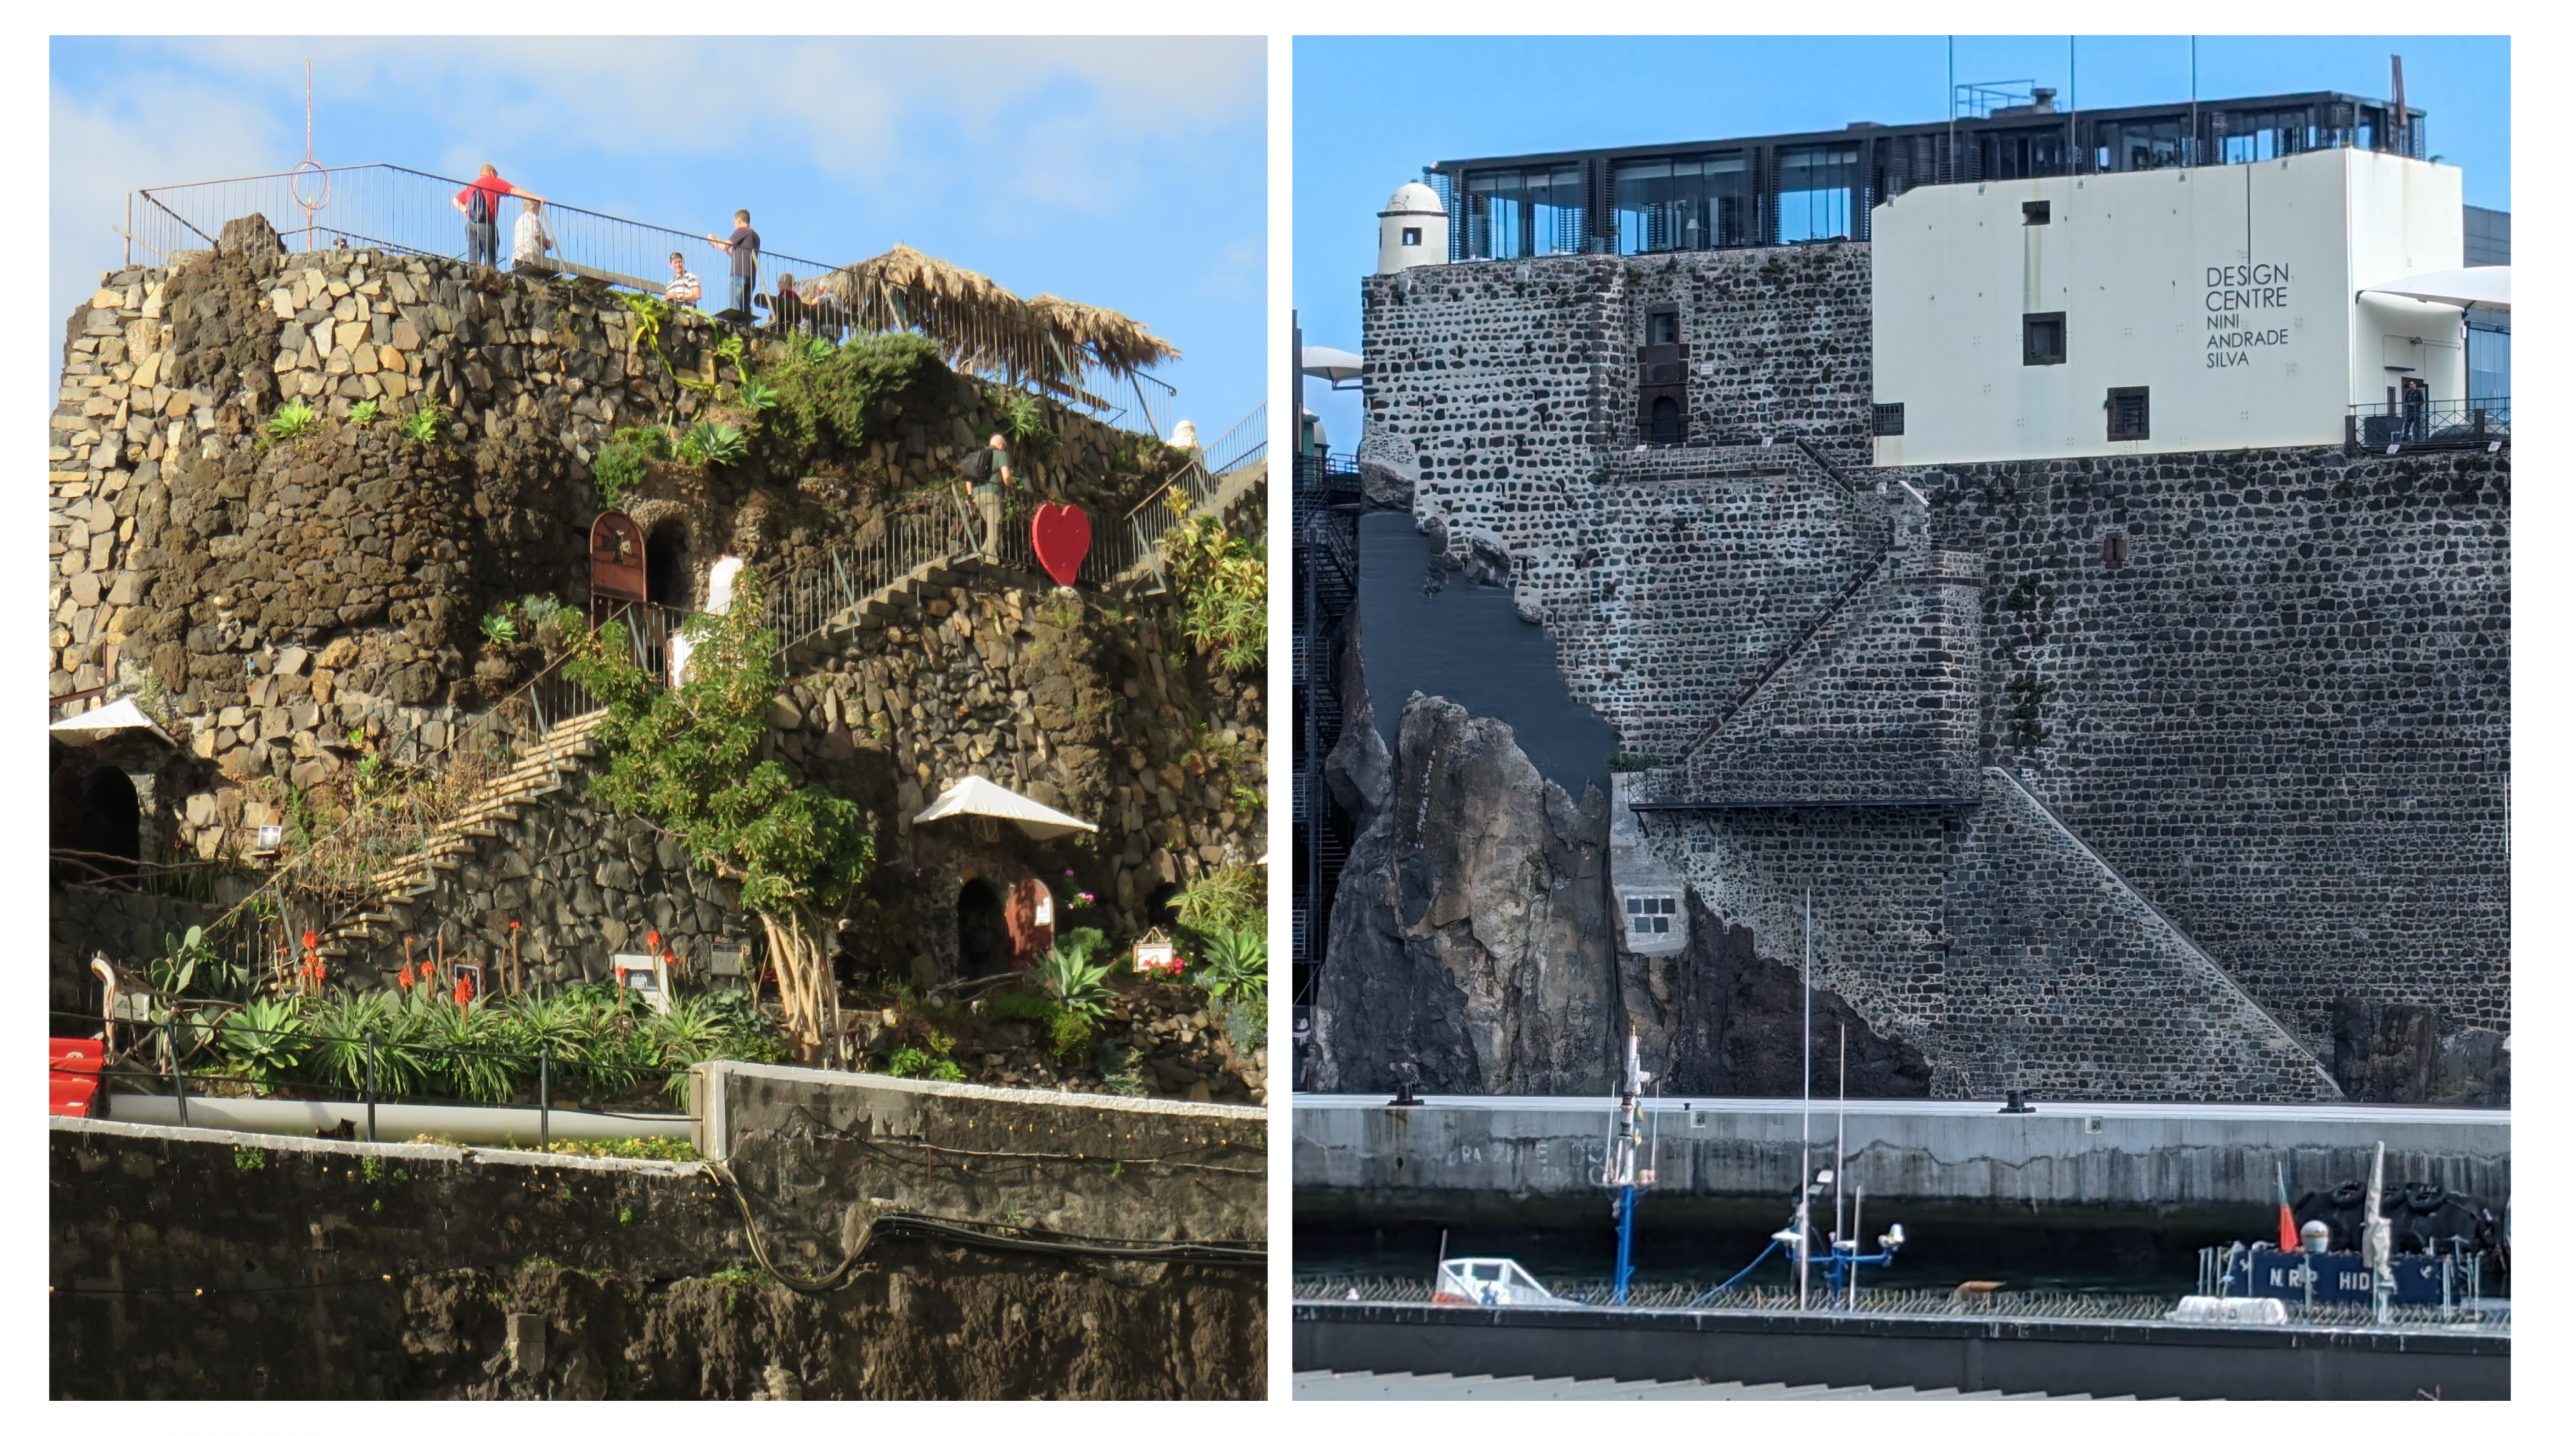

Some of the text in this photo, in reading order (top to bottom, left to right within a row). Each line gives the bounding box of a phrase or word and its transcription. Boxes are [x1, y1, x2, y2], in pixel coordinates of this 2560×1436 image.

[2207, 263, 2289, 288] DESIGN
[2206, 286, 2287, 312] CENTRE
[2207, 313, 2239, 331] NINI
[2207, 329, 2289, 349] ANDRADE
[2207, 351, 2249, 369] SILVA
